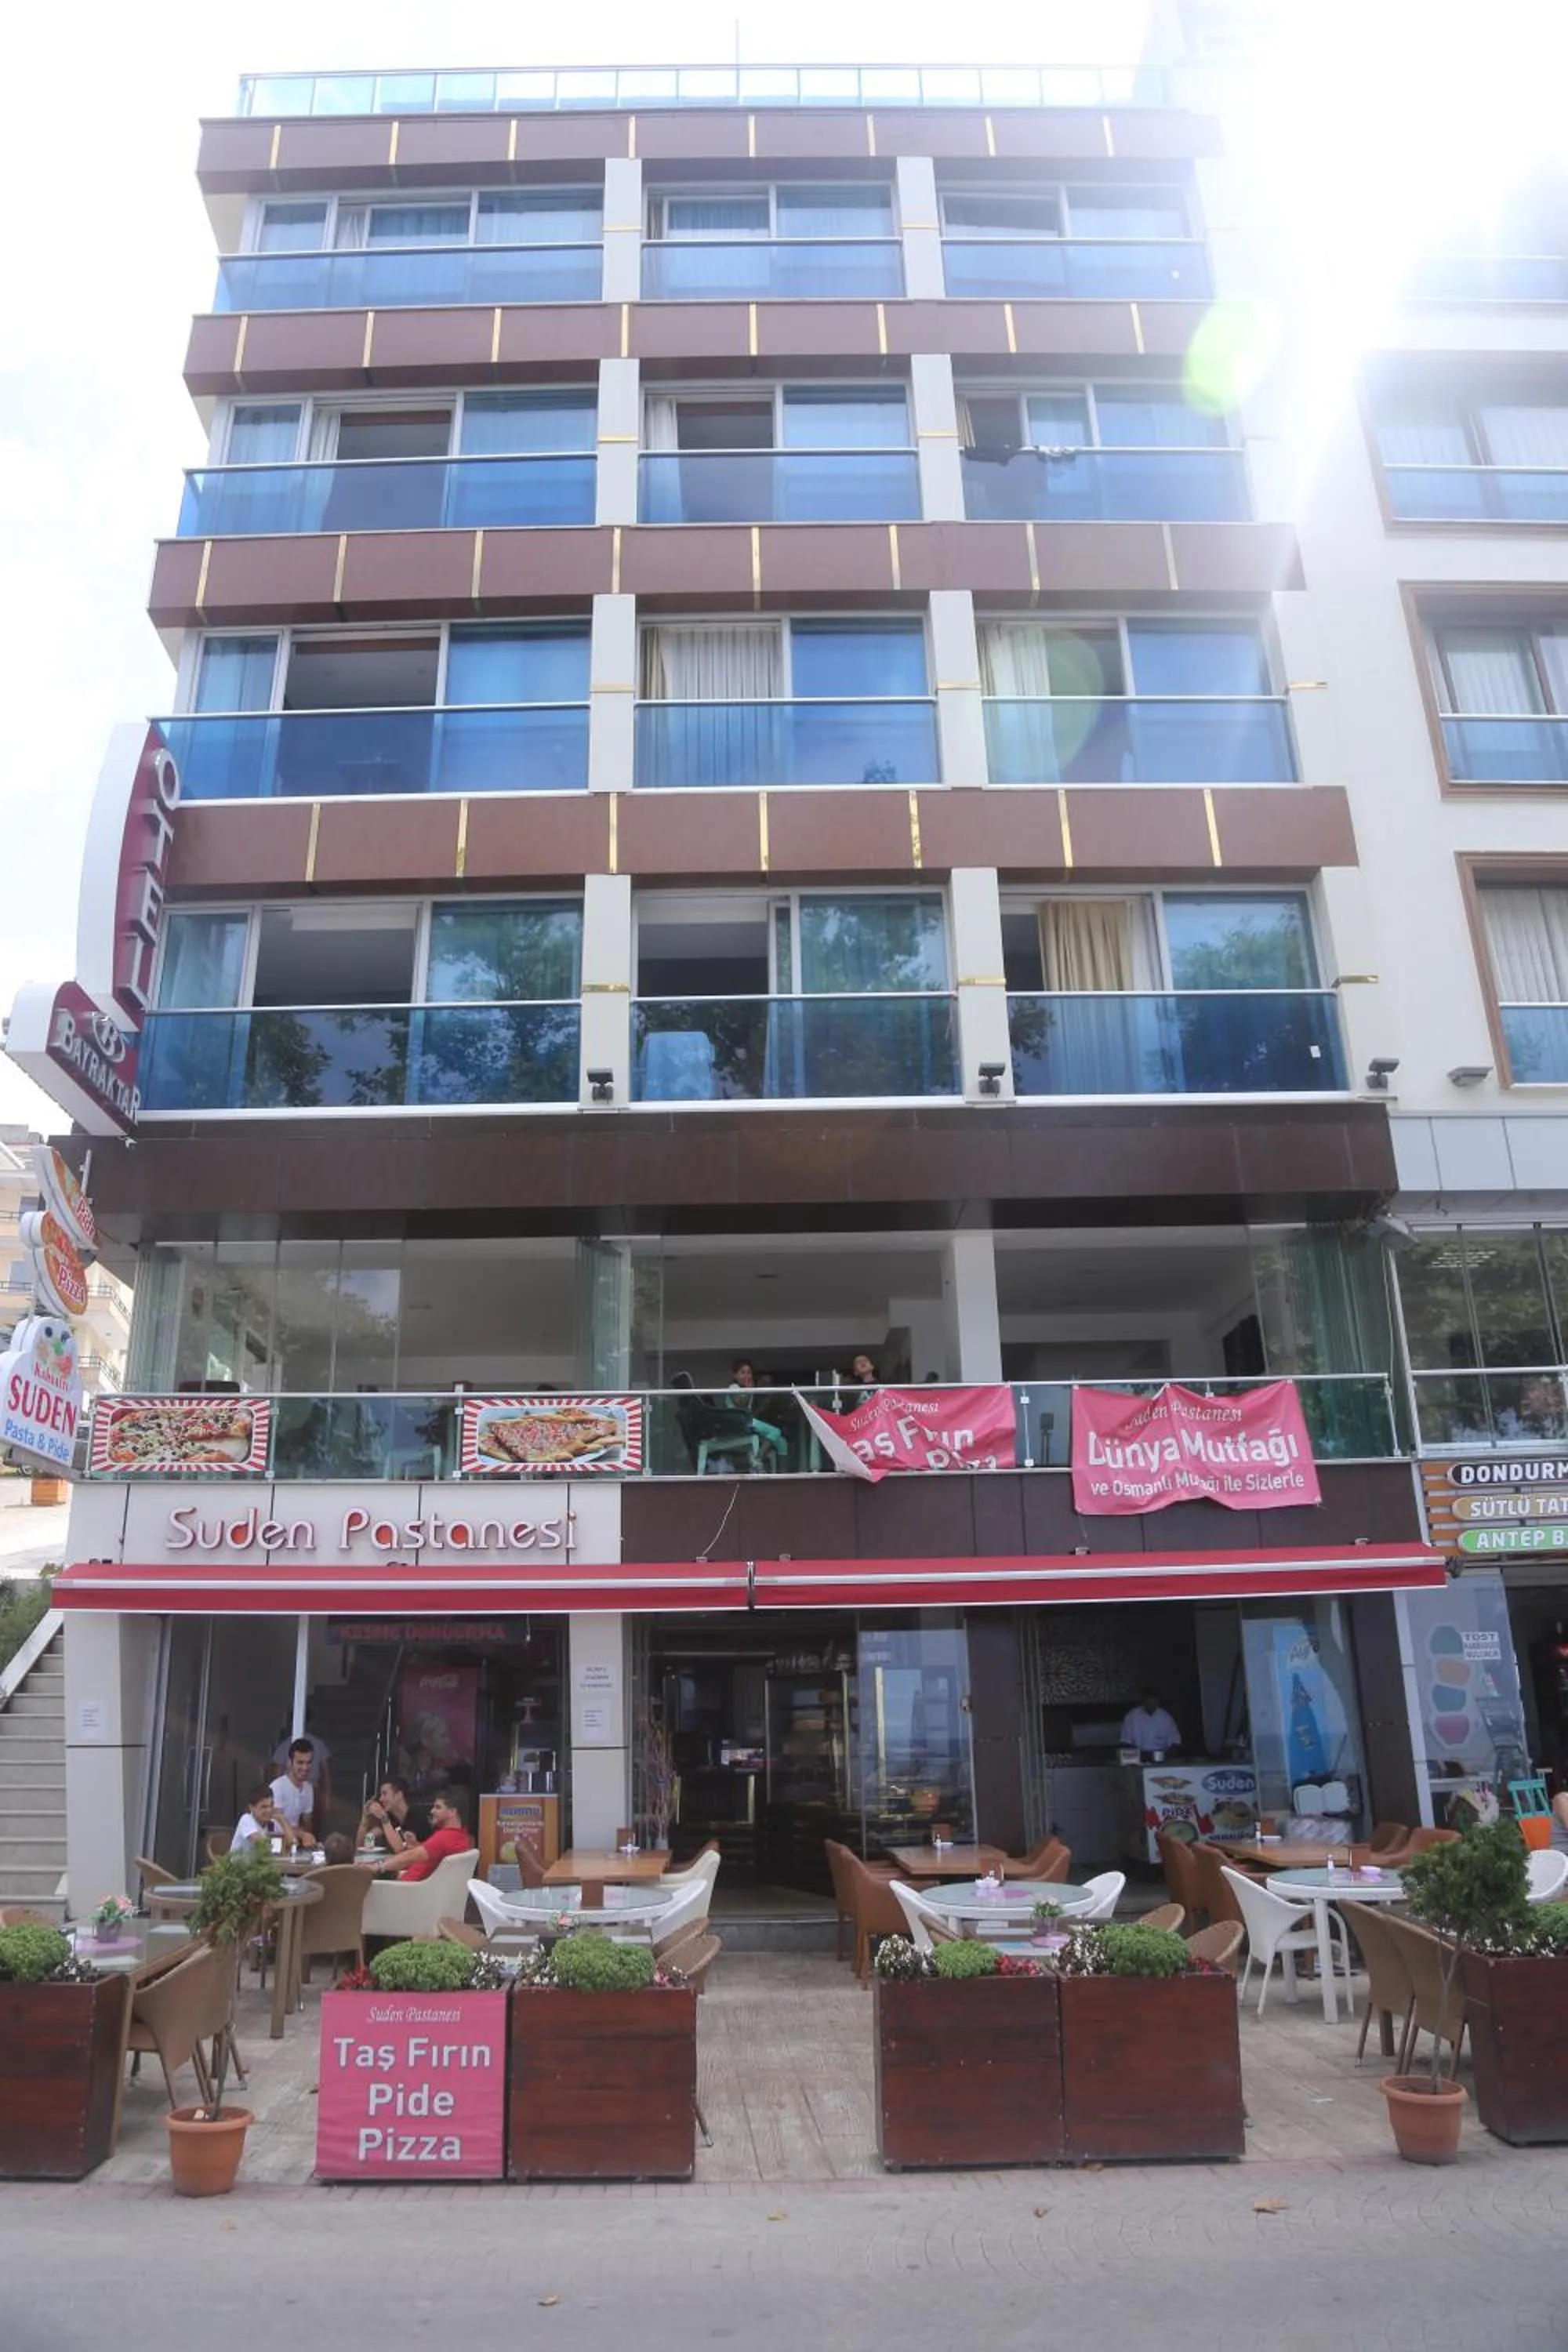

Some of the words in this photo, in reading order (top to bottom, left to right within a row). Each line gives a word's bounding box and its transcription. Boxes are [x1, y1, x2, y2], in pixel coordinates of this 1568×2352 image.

[122, 747, 180, 1011] OTEL
[55, 1008, 141, 1126] BAYRAKTAR
[8, 1374, 77, 1437] SUDEN
[5, 1417, 34, 1446] Pasta
[38, 1433, 46, 1450] &
[48, 1436, 71, 1461] Pide
[1181, 1428, 1299, 1468] Mutfağı
[1091, 1482, 1109, 1496] ve
[1112, 1475, 1172, 1497] Osmanlı
[1224, 1474, 1243, 1492] ile
[1245, 1471, 1305, 1492] Sizlerle
[1470, 1494, 1530, 1517] SÜTLÜ
[165, 1507, 316, 1551] Suden
[339, 1507, 578, 1551] Pastanesi
[1477, 1529, 1545, 1548] ANTEP
[1207, 1777, 1255, 1790] Suden
[367, 2004, 405, 2023] Suden
[406, 2006, 463, 2023] Pastanesi
[333, 2038, 395, 2071] Taş
[407, 2038, 491, 2067] Fırın
[368, 2083, 455, 2117] Pide
[358, 2128, 461, 2161] Pizza
